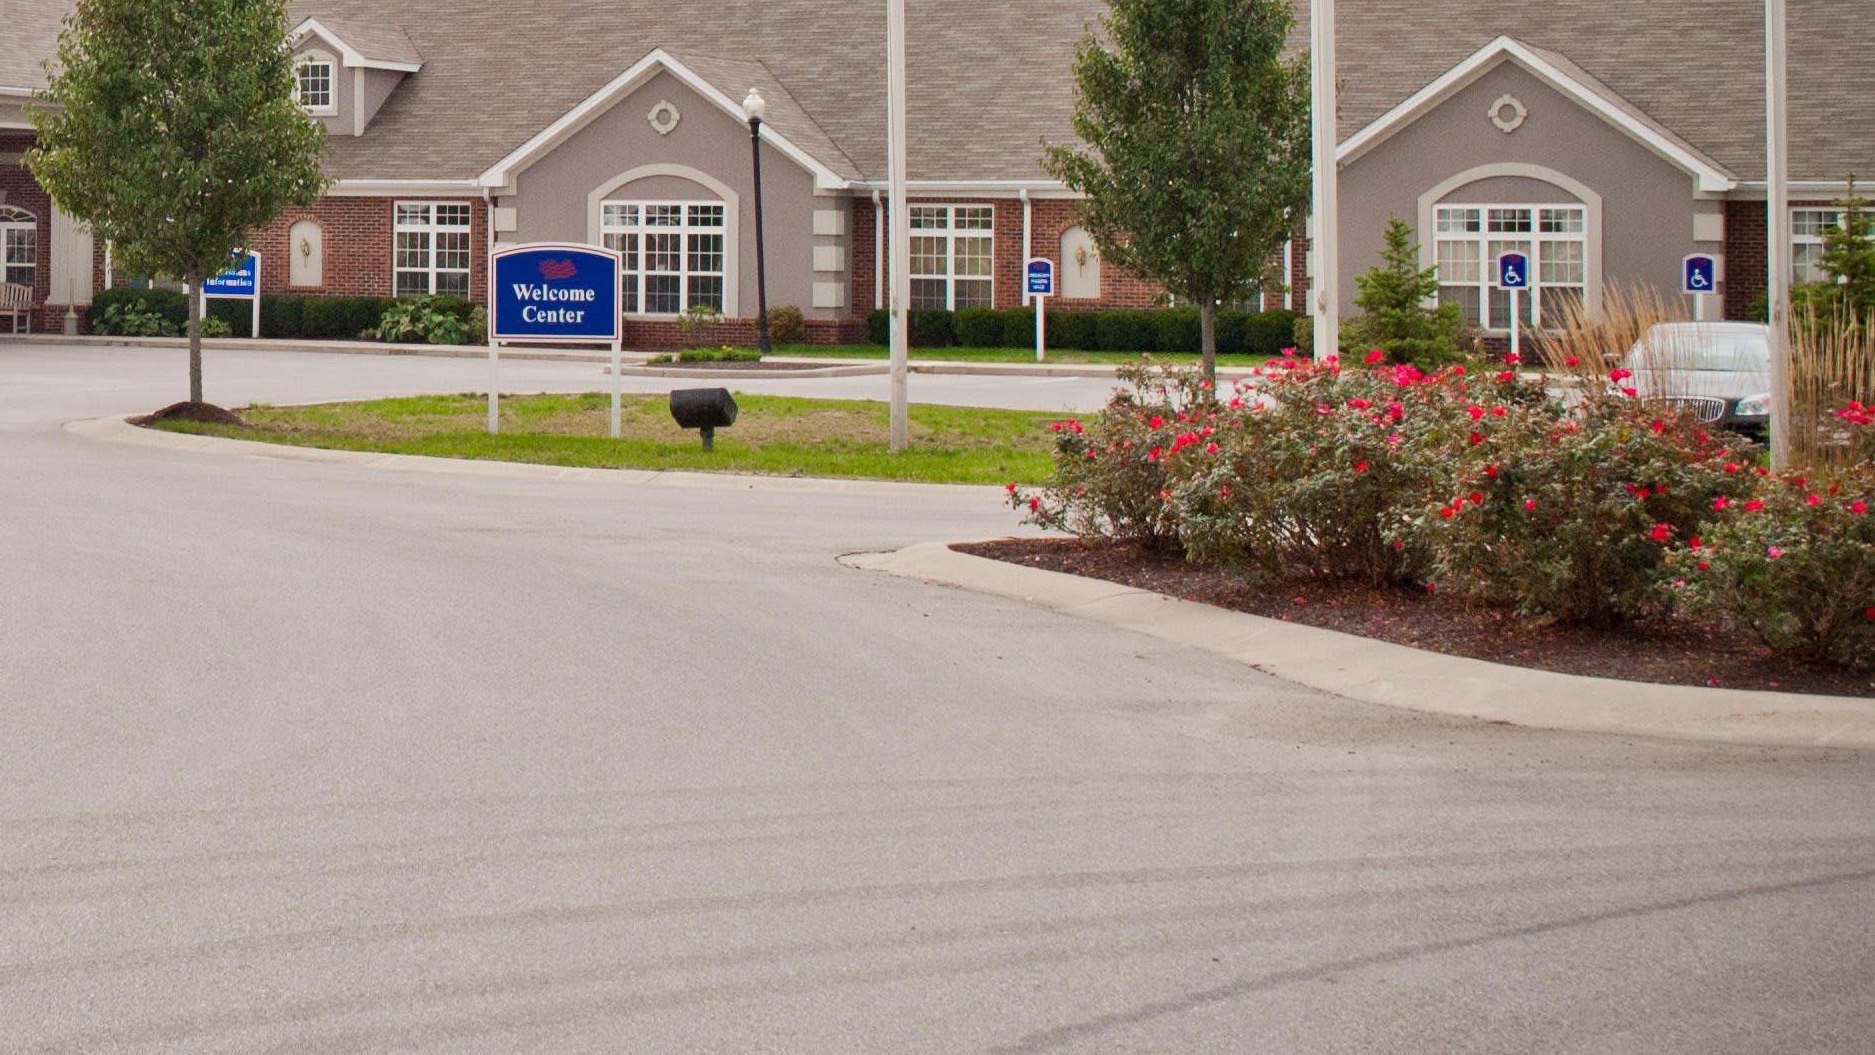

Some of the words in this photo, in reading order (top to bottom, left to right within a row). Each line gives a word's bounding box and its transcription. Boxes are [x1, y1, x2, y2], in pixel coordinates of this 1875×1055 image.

[206, 277, 252, 286] Information
[512, 283, 595, 302] Welcome
[522, 305, 585, 323] Center
